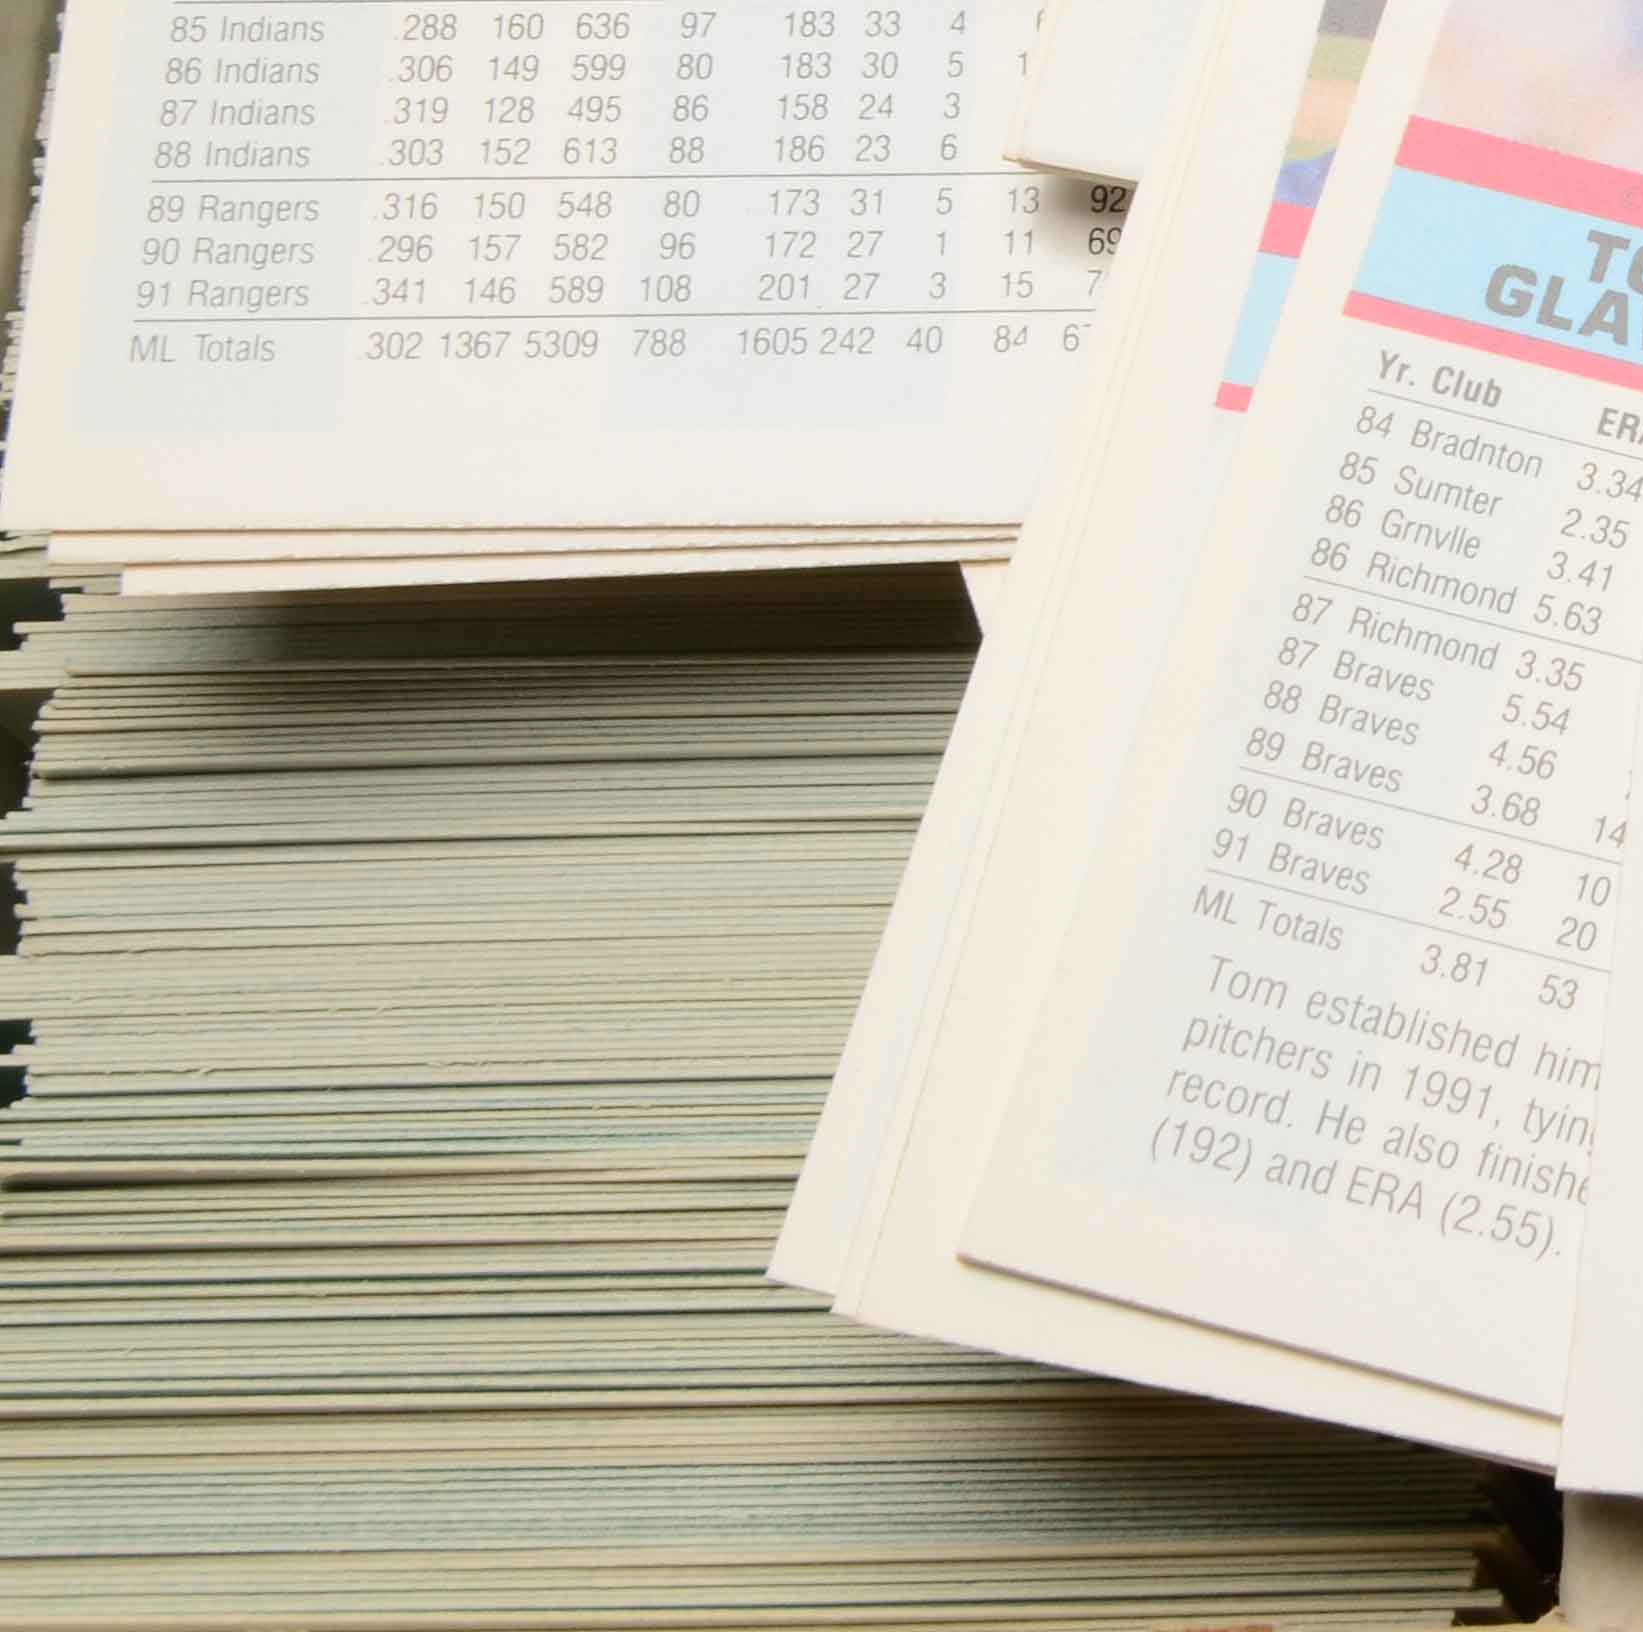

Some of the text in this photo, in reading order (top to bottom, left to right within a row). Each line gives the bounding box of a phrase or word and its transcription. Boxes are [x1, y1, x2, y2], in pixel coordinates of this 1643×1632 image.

[128, 331, 277, 364] ML Totals
[1353, 403, 1396, 440] 84
[1407, 416, 1545, 479] Bradnton
[1322, 492, 1483, 561] 86 Grnvlle
[1207, 952, 1521, 1070] Tom established
[1163, 1067, 1461, 1171] record. He also
[1179, 1012, 1502, 1131] pitchers in 1991,
[1148, 1114, 1562, 1262] (192) and ERA (2.55).
